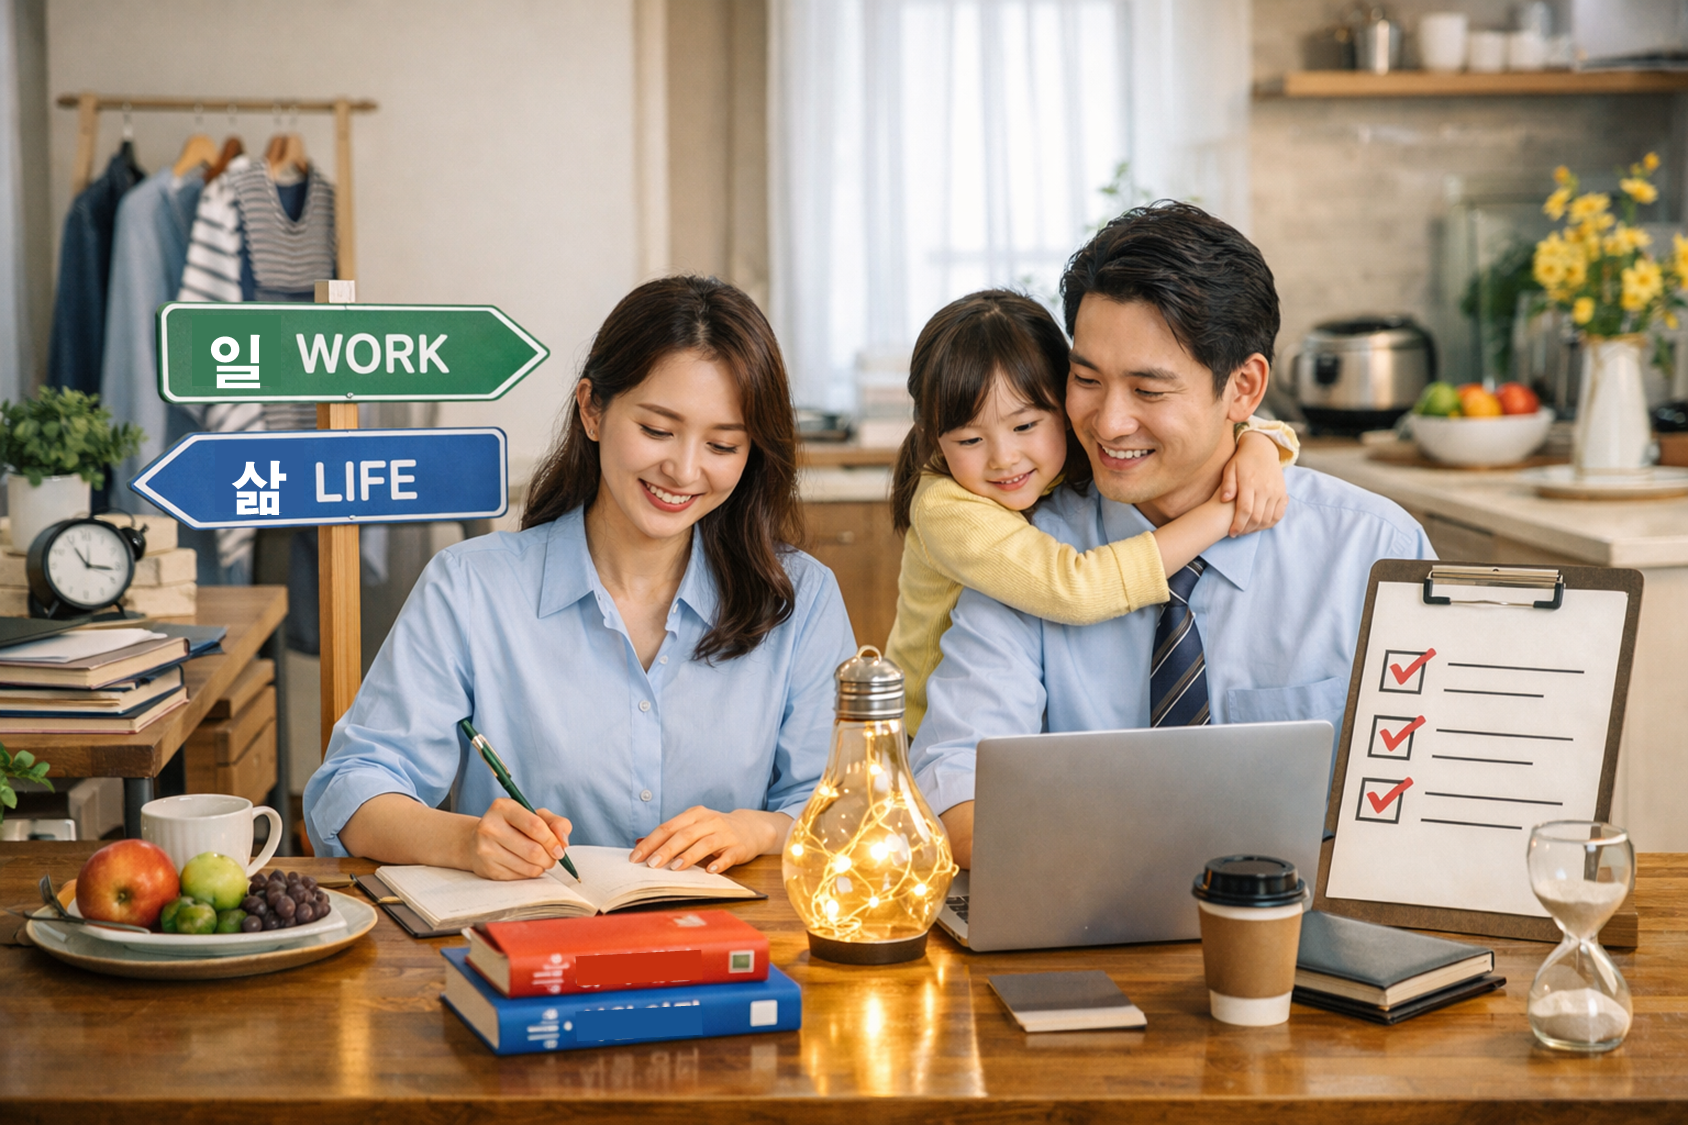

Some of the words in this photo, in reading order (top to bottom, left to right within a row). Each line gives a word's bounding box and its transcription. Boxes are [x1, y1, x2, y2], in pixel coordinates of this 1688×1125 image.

[210, 334, 261, 389] 일
[295, 332, 450, 375] WORK
[231, 460, 287, 516] 삶
[315, 459, 418, 503] LIFE
